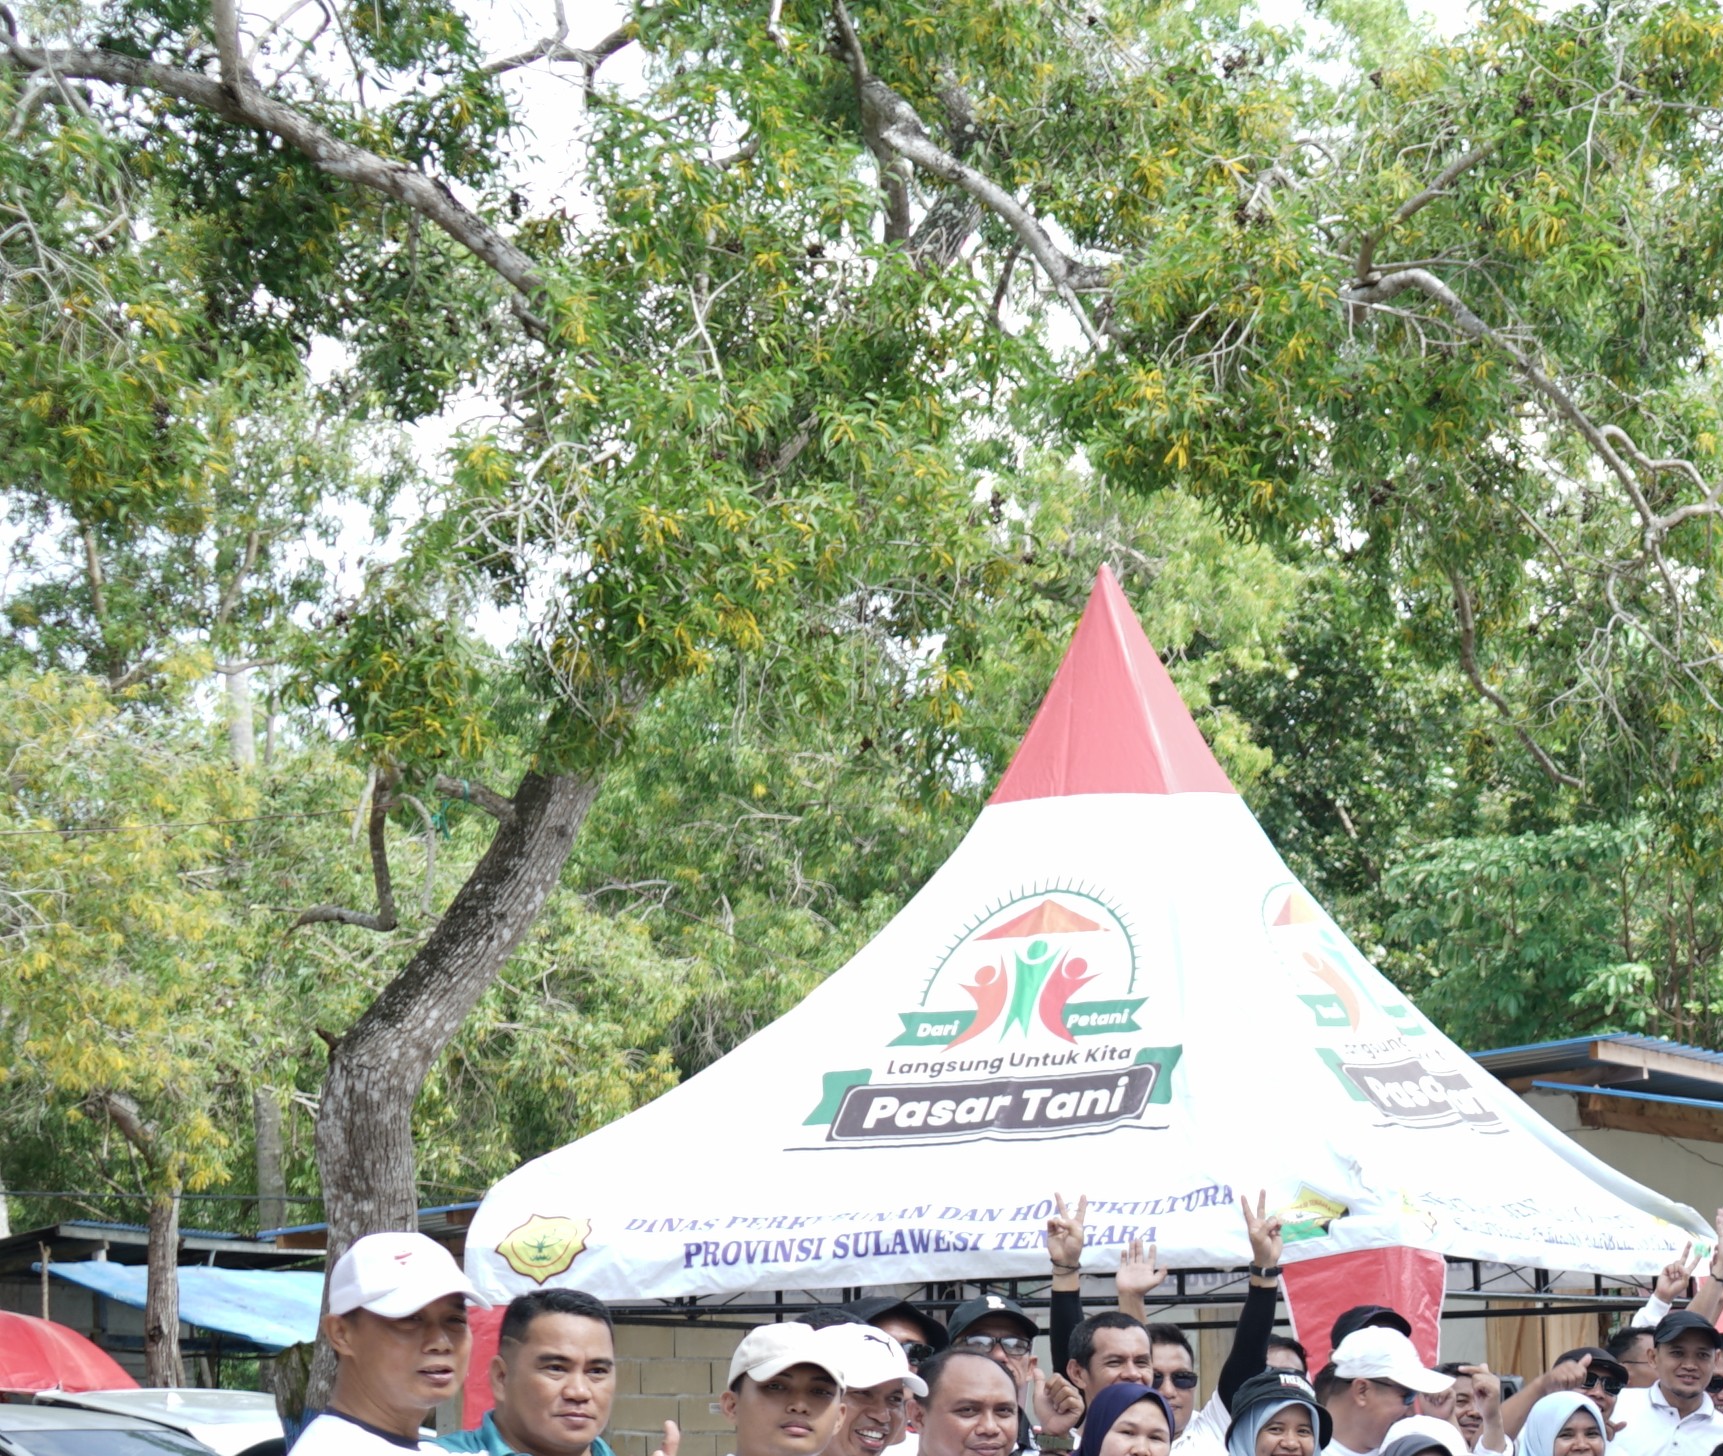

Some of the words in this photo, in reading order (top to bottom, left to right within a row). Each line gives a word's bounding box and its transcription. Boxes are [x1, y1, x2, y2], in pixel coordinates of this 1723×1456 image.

[916, 1020, 961, 1038] Dari
[1066, 1008, 1129, 1028] Petani
[886, 1055, 1003, 1078] Langsung
[1009, 1049, 1077, 1069] Untuk
[1084, 1046, 1132, 1064] Kita
[862, 1096, 1013, 1130] Pasar
[1021, 1075, 1130, 1122] Tani
[938, 1206, 1004, 1221] DAN
[683, 1237, 827, 1268] PROVINSI
[832, 1228, 984, 1259] SULAWESI
[992, 1224, 1158, 1252] TENGARA
